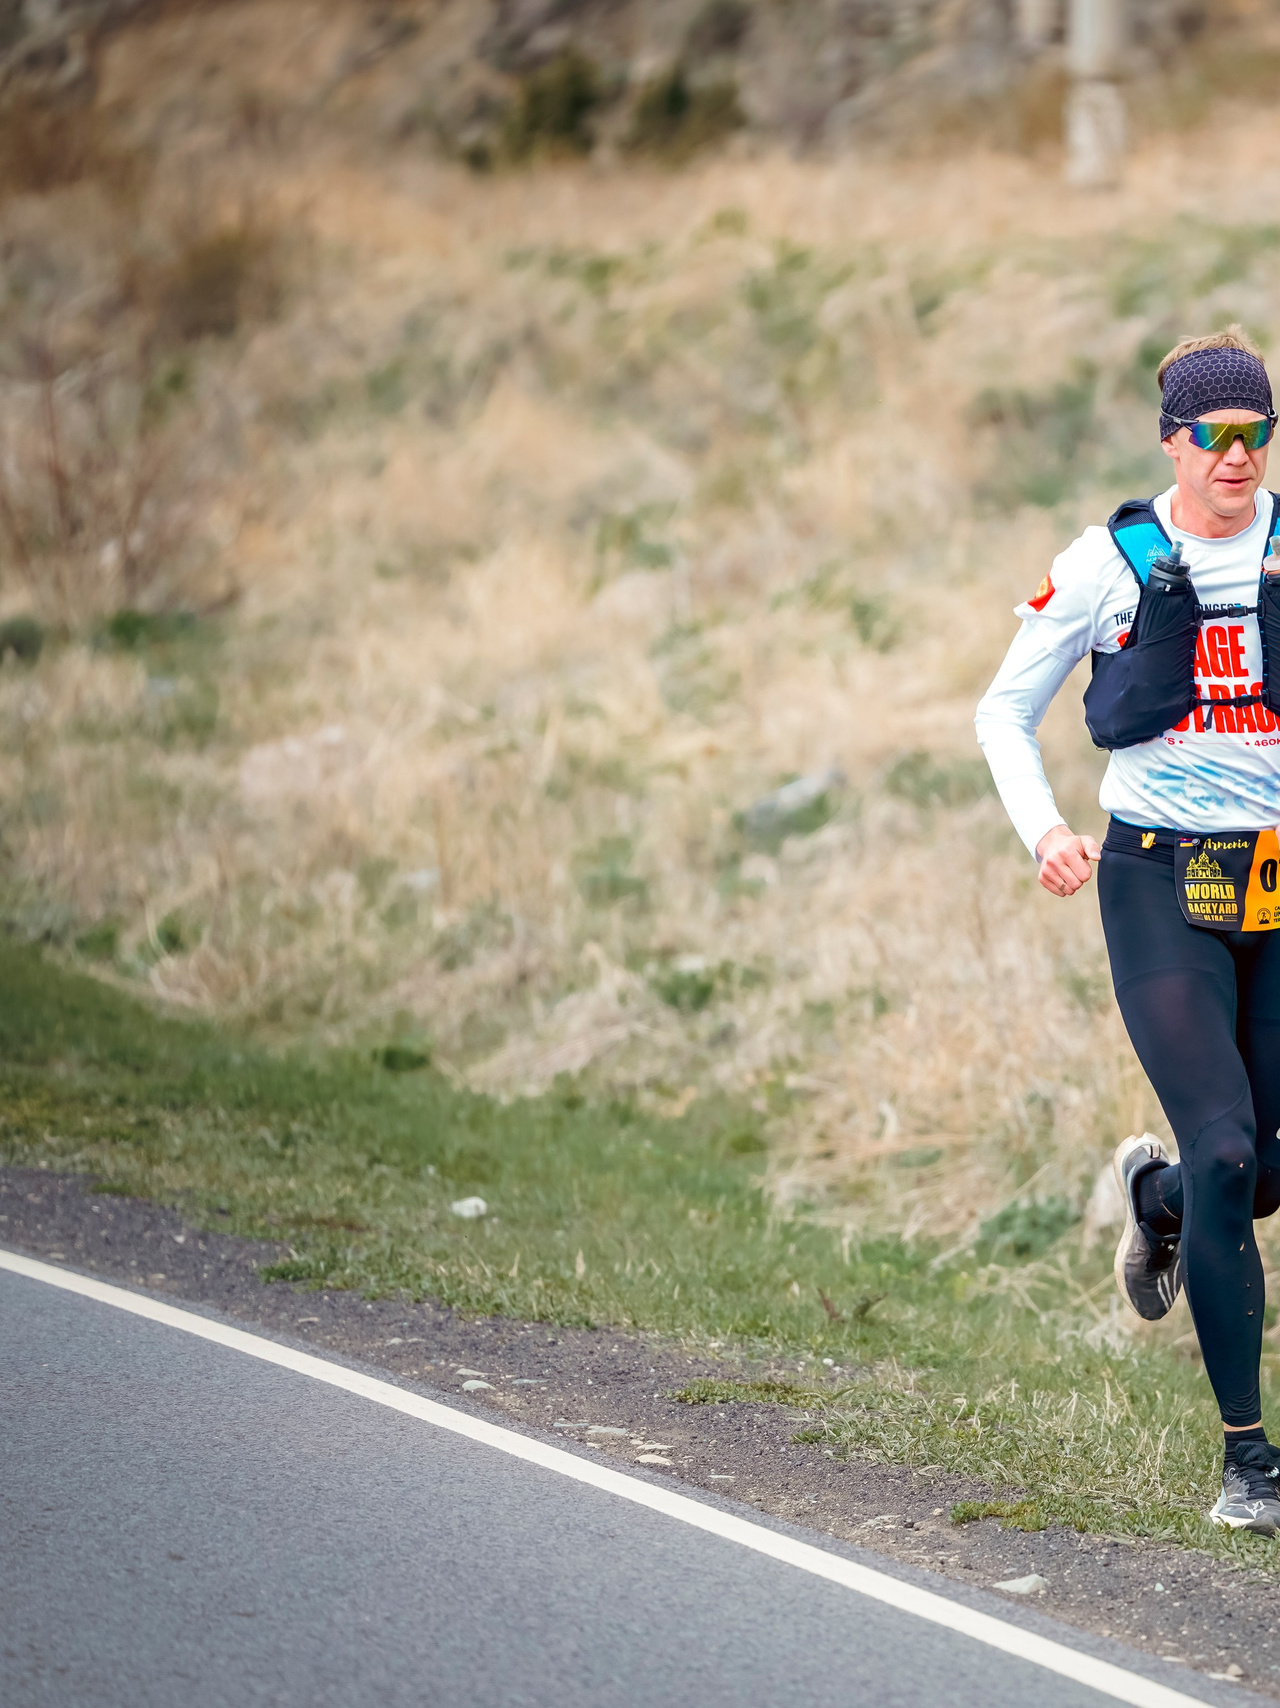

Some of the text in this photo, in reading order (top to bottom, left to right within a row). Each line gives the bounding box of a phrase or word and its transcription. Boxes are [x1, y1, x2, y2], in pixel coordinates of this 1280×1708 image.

[1114, 611, 1134, 626] THE
[1203, 838, 1250, 850] Armenia
[1185, 884, 1235, 899] WORLD
[1187, 903, 1238, 915] BACKYARD
[1203, 914, 1224, 922] ULTRA
